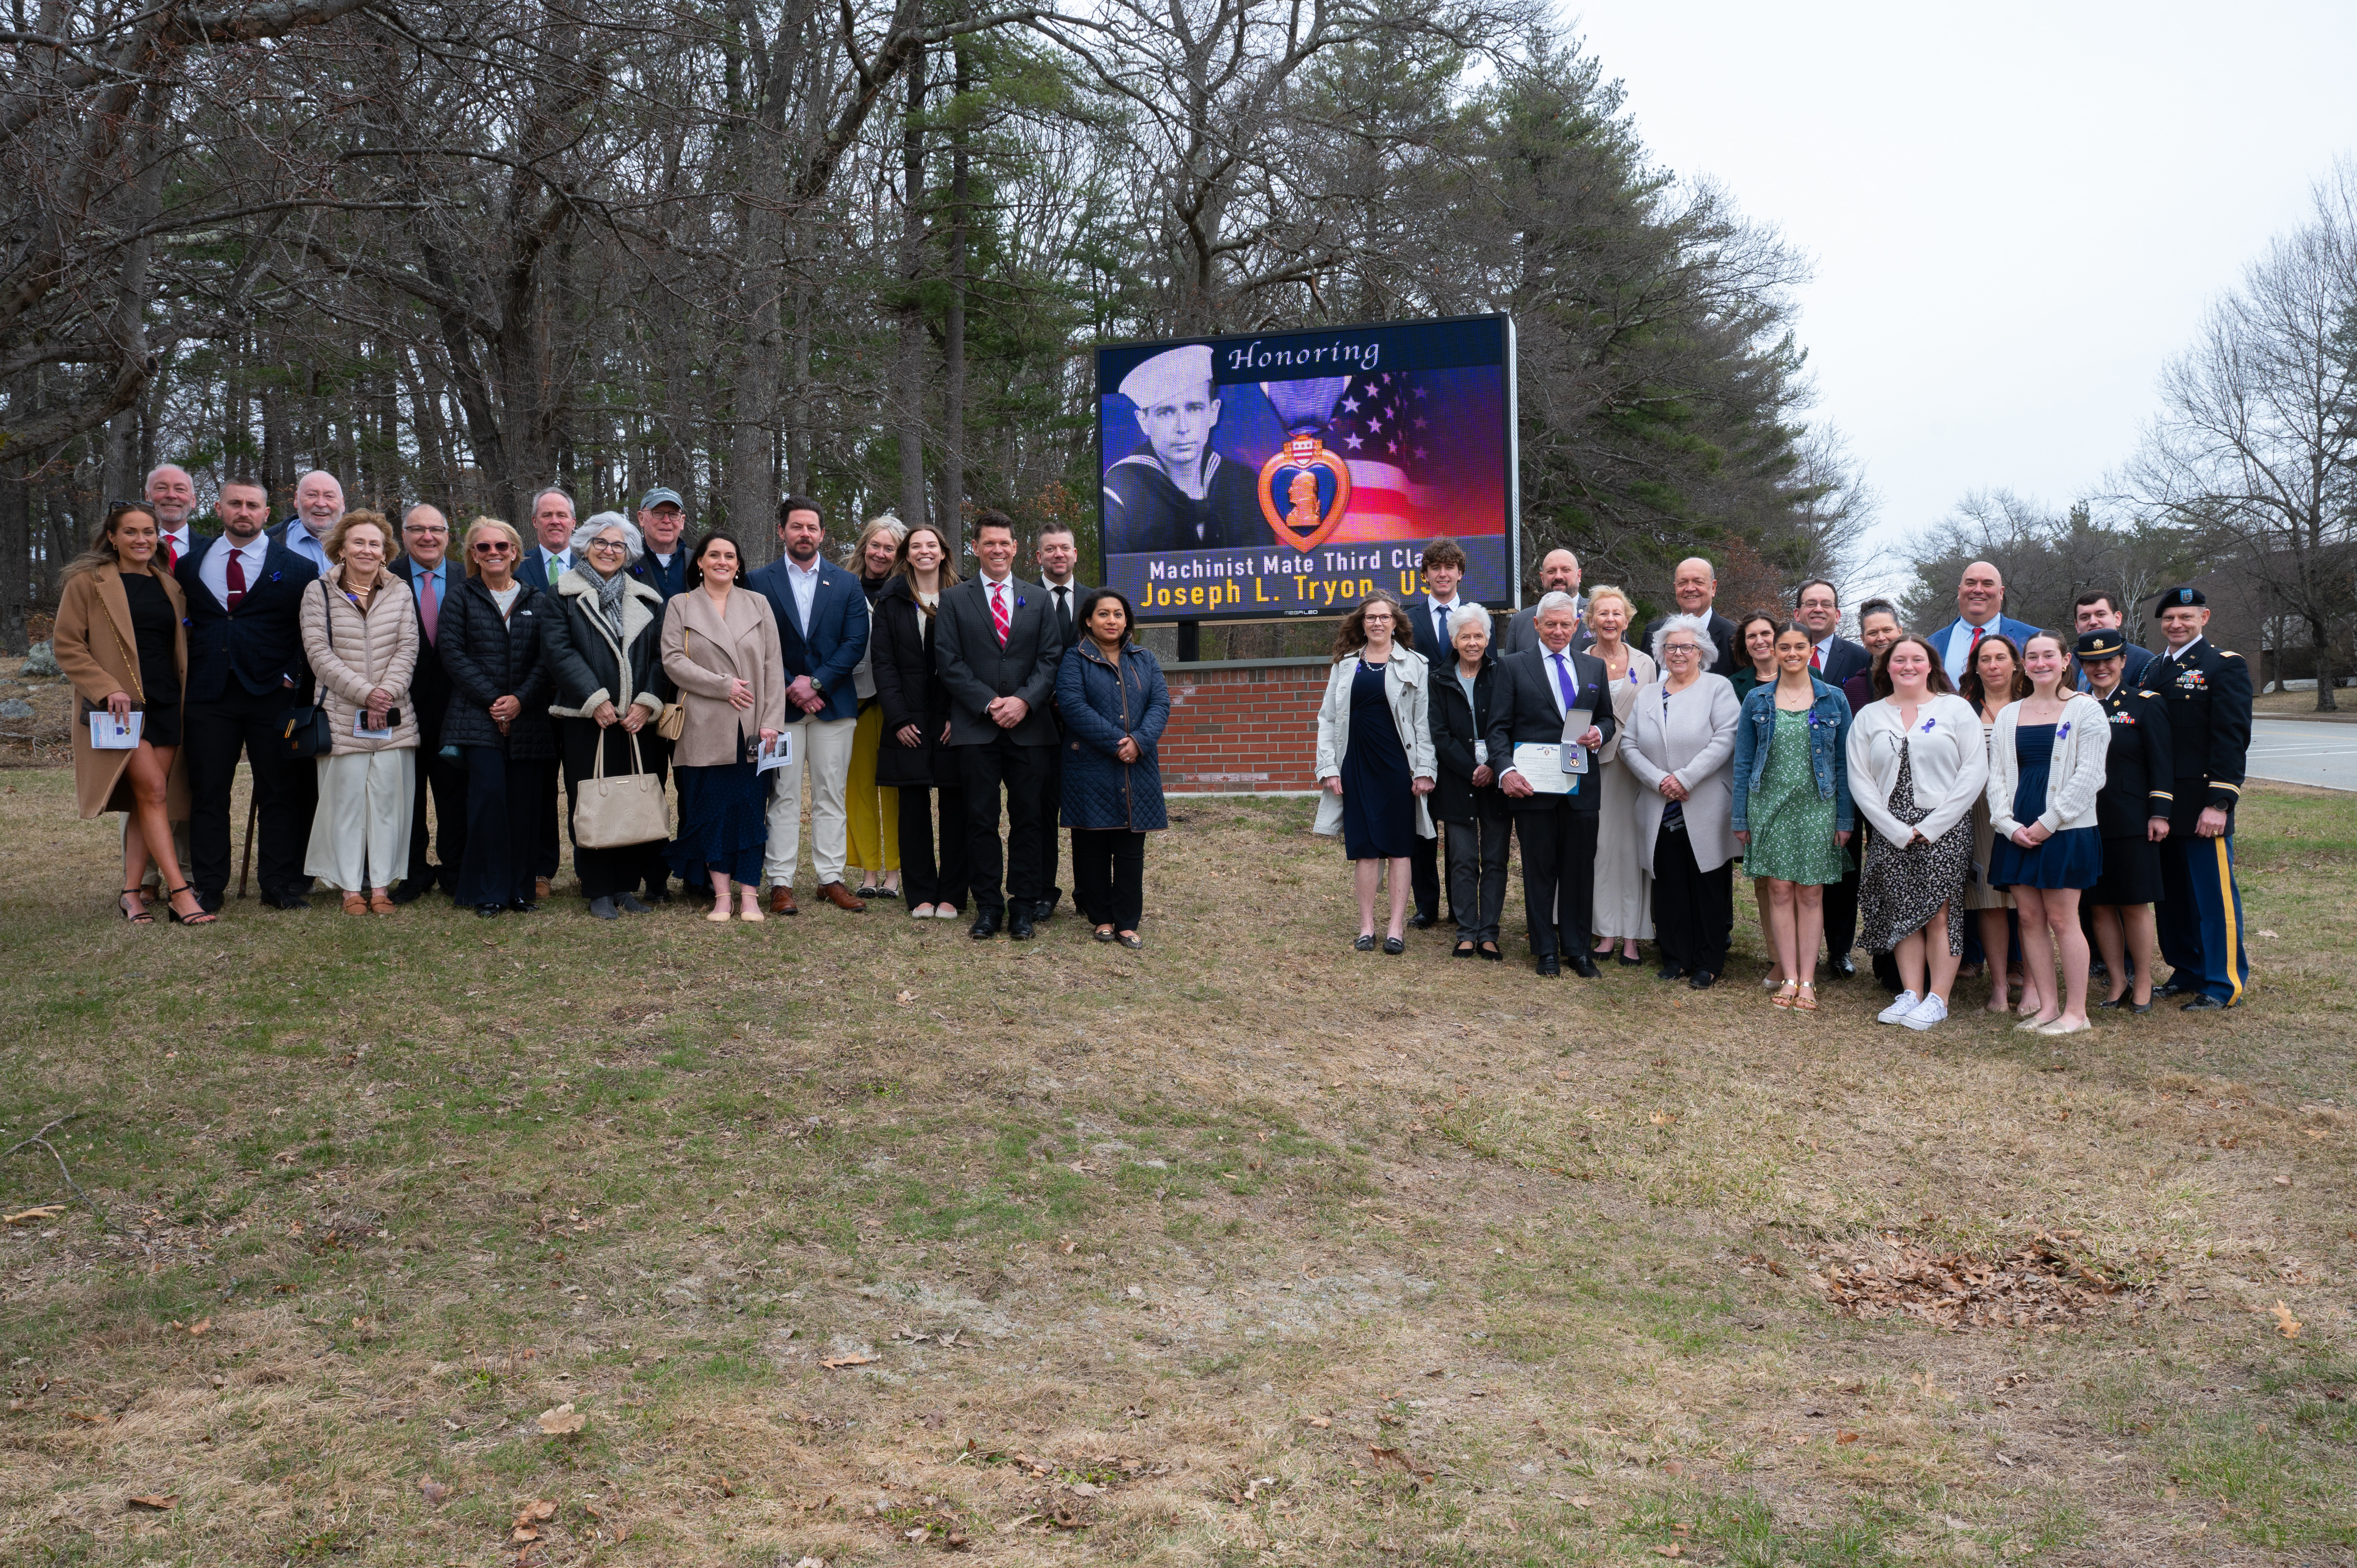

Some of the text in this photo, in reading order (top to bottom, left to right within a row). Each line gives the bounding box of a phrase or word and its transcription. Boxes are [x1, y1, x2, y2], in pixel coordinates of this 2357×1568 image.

[1228, 340, 1379, 370] Honoring
[1150, 548, 1423, 580] Machinist Mate Third Cla
[1140, 578, 1240, 610] Joseph
[1256, 577, 1279, 602] L.
[1294, 575, 1373, 605] Tryon
